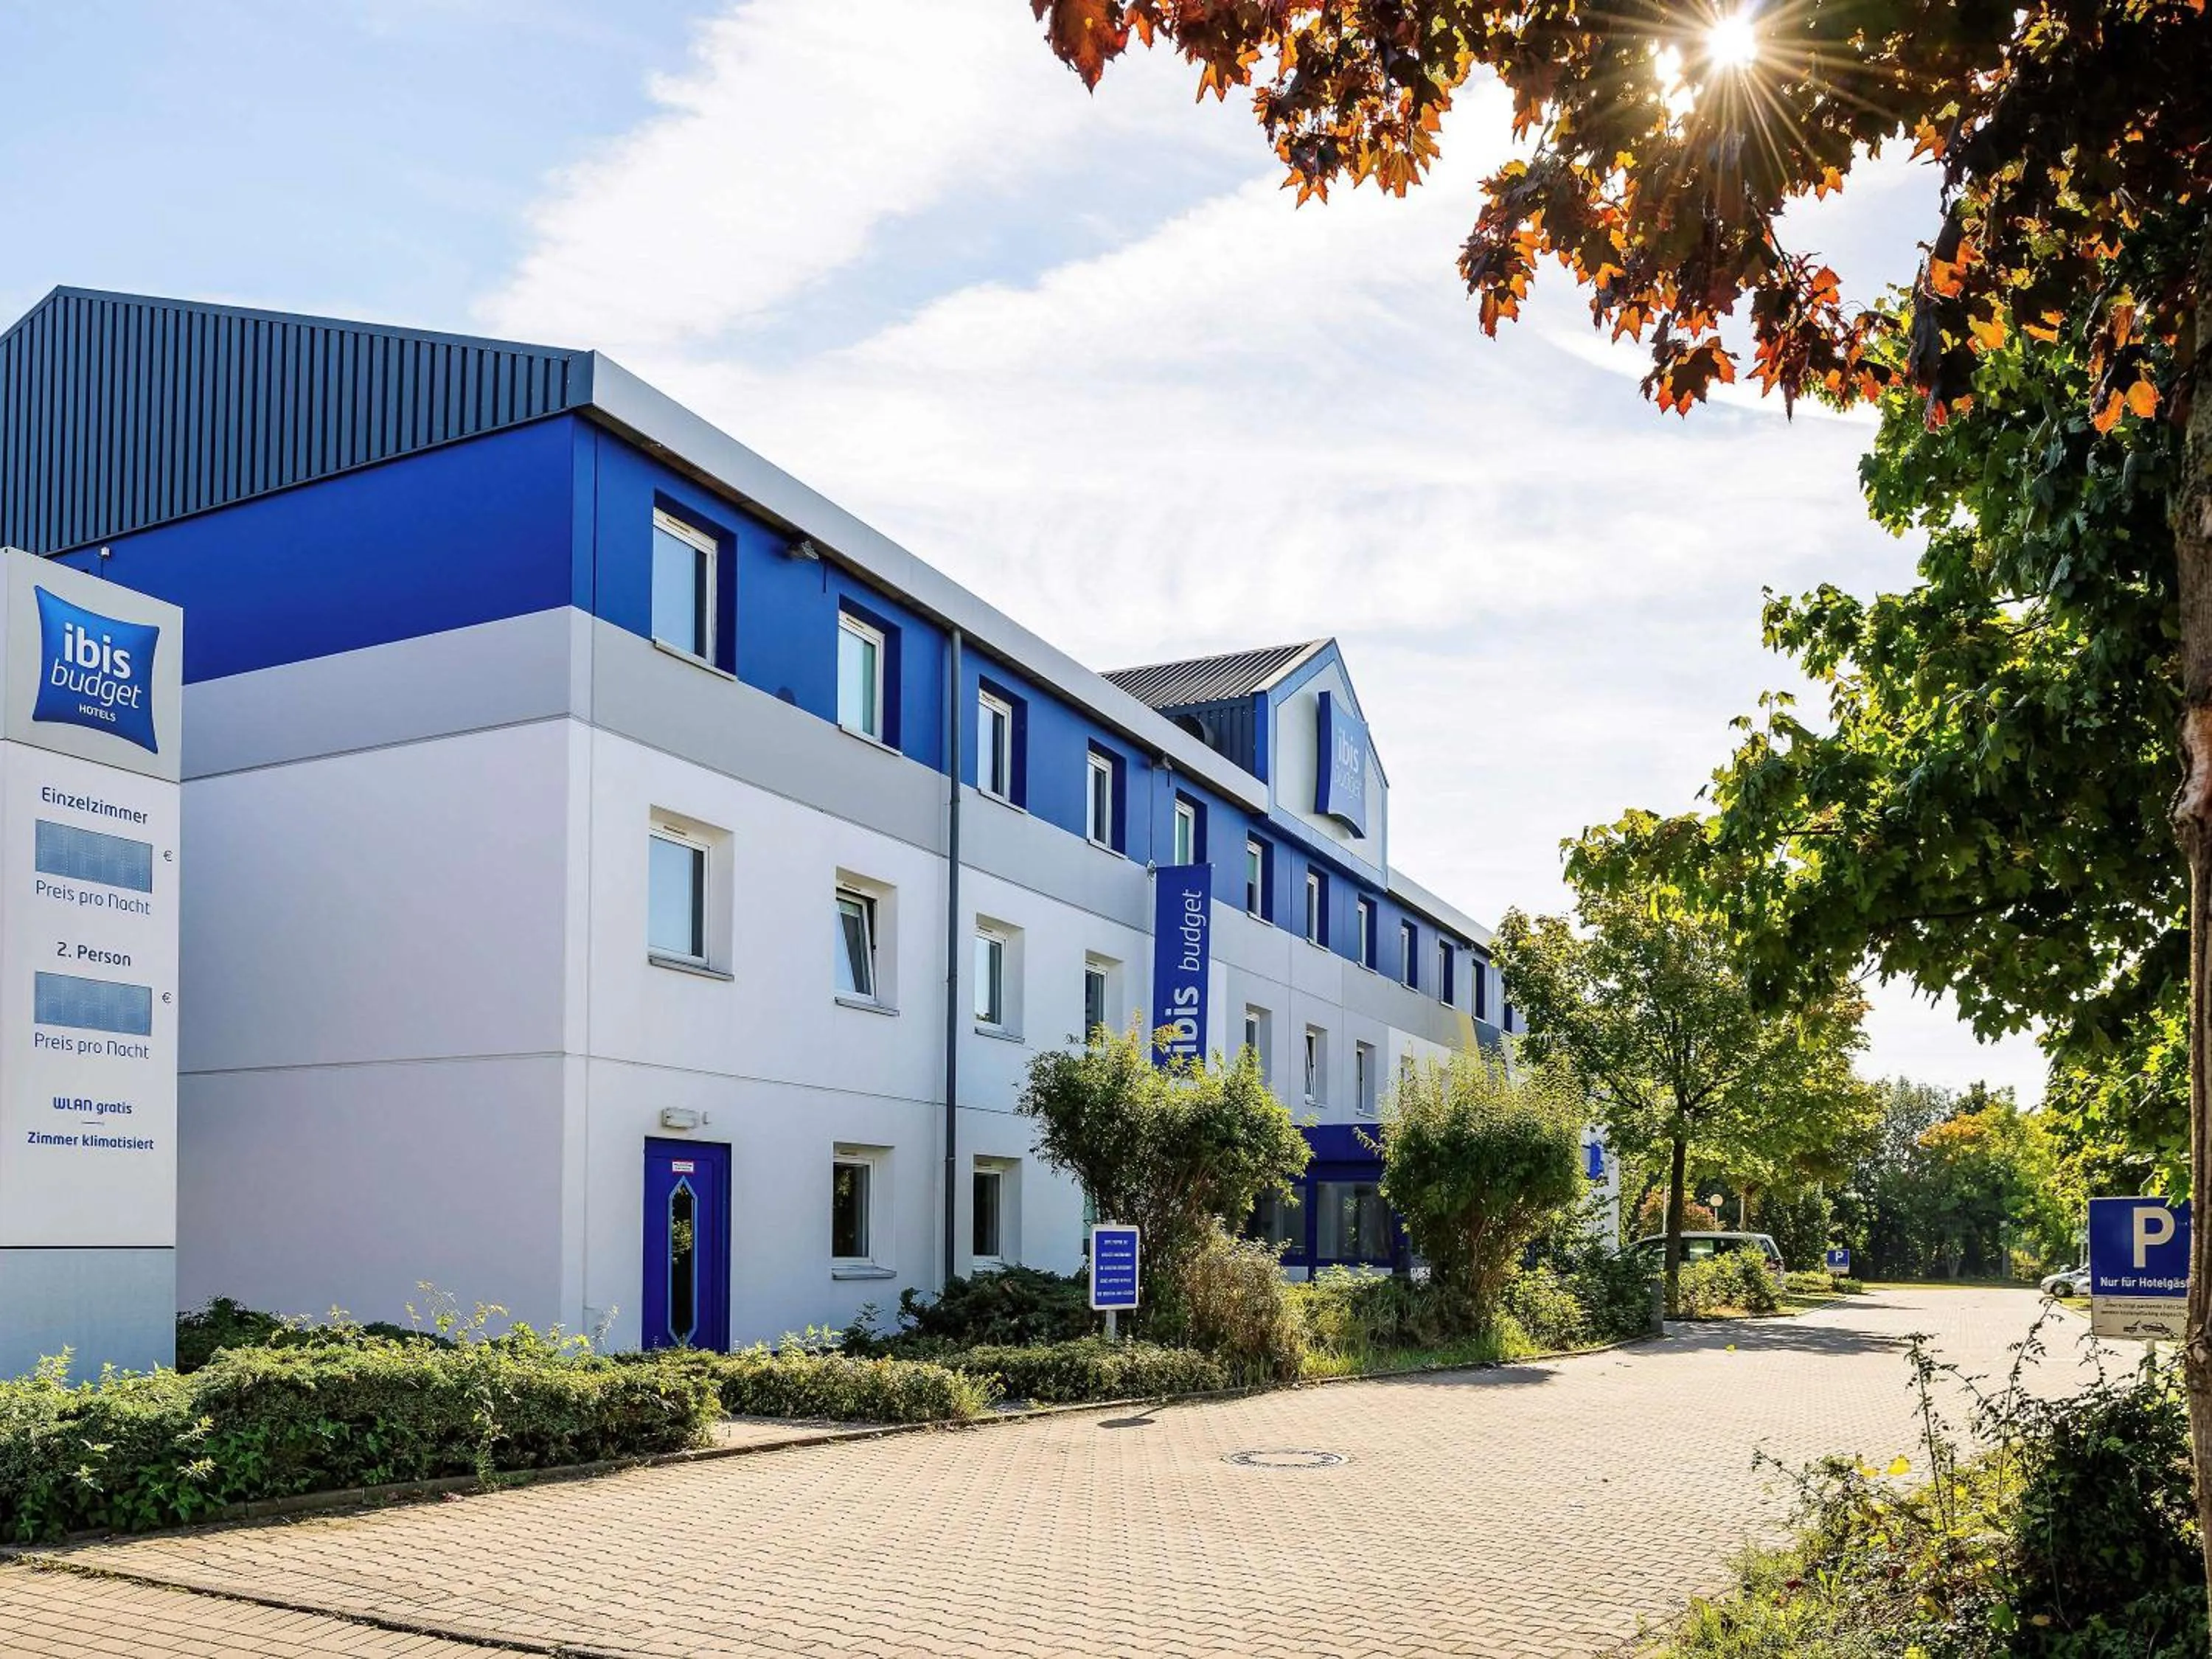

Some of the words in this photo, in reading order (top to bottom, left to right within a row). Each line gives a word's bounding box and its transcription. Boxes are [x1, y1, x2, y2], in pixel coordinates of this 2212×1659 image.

[64, 622, 131, 679] ibis
[51, 658, 142, 709] budget
[79, 703, 116, 722] HOTELS
[1338, 726, 1360, 774] ibis
[42, 787, 148, 824] Einzelzimmer
[163, 850, 173, 862] €
[36, 880, 74, 901] Preis
[79, 891, 104, 906] pro
[108, 894, 150, 915] Nacht
[1178, 888, 1206, 972] budget
[57, 942, 72, 958] 2.
[77, 945, 131, 967] Person
[161, 992, 172, 1004] €
[1165, 986, 1199, 1053] ibis
[35, 1032, 73, 1051] Preis
[77, 1040, 102, 1055] pro
[107, 1040, 150, 1060] Nacht
[53, 1096, 92, 1111] WLAN
[97, 1102, 133, 1115] gratis
[27, 1132, 77, 1147] Zimmer
[82, 1134, 154, 1150] klimatisiert
[2133, 1206, 2175, 1267] P
[1835, 1251, 1844, 1262] P
[2100, 1276, 2118, 1287] Nur
[2121, 1276, 2137, 1287] für
